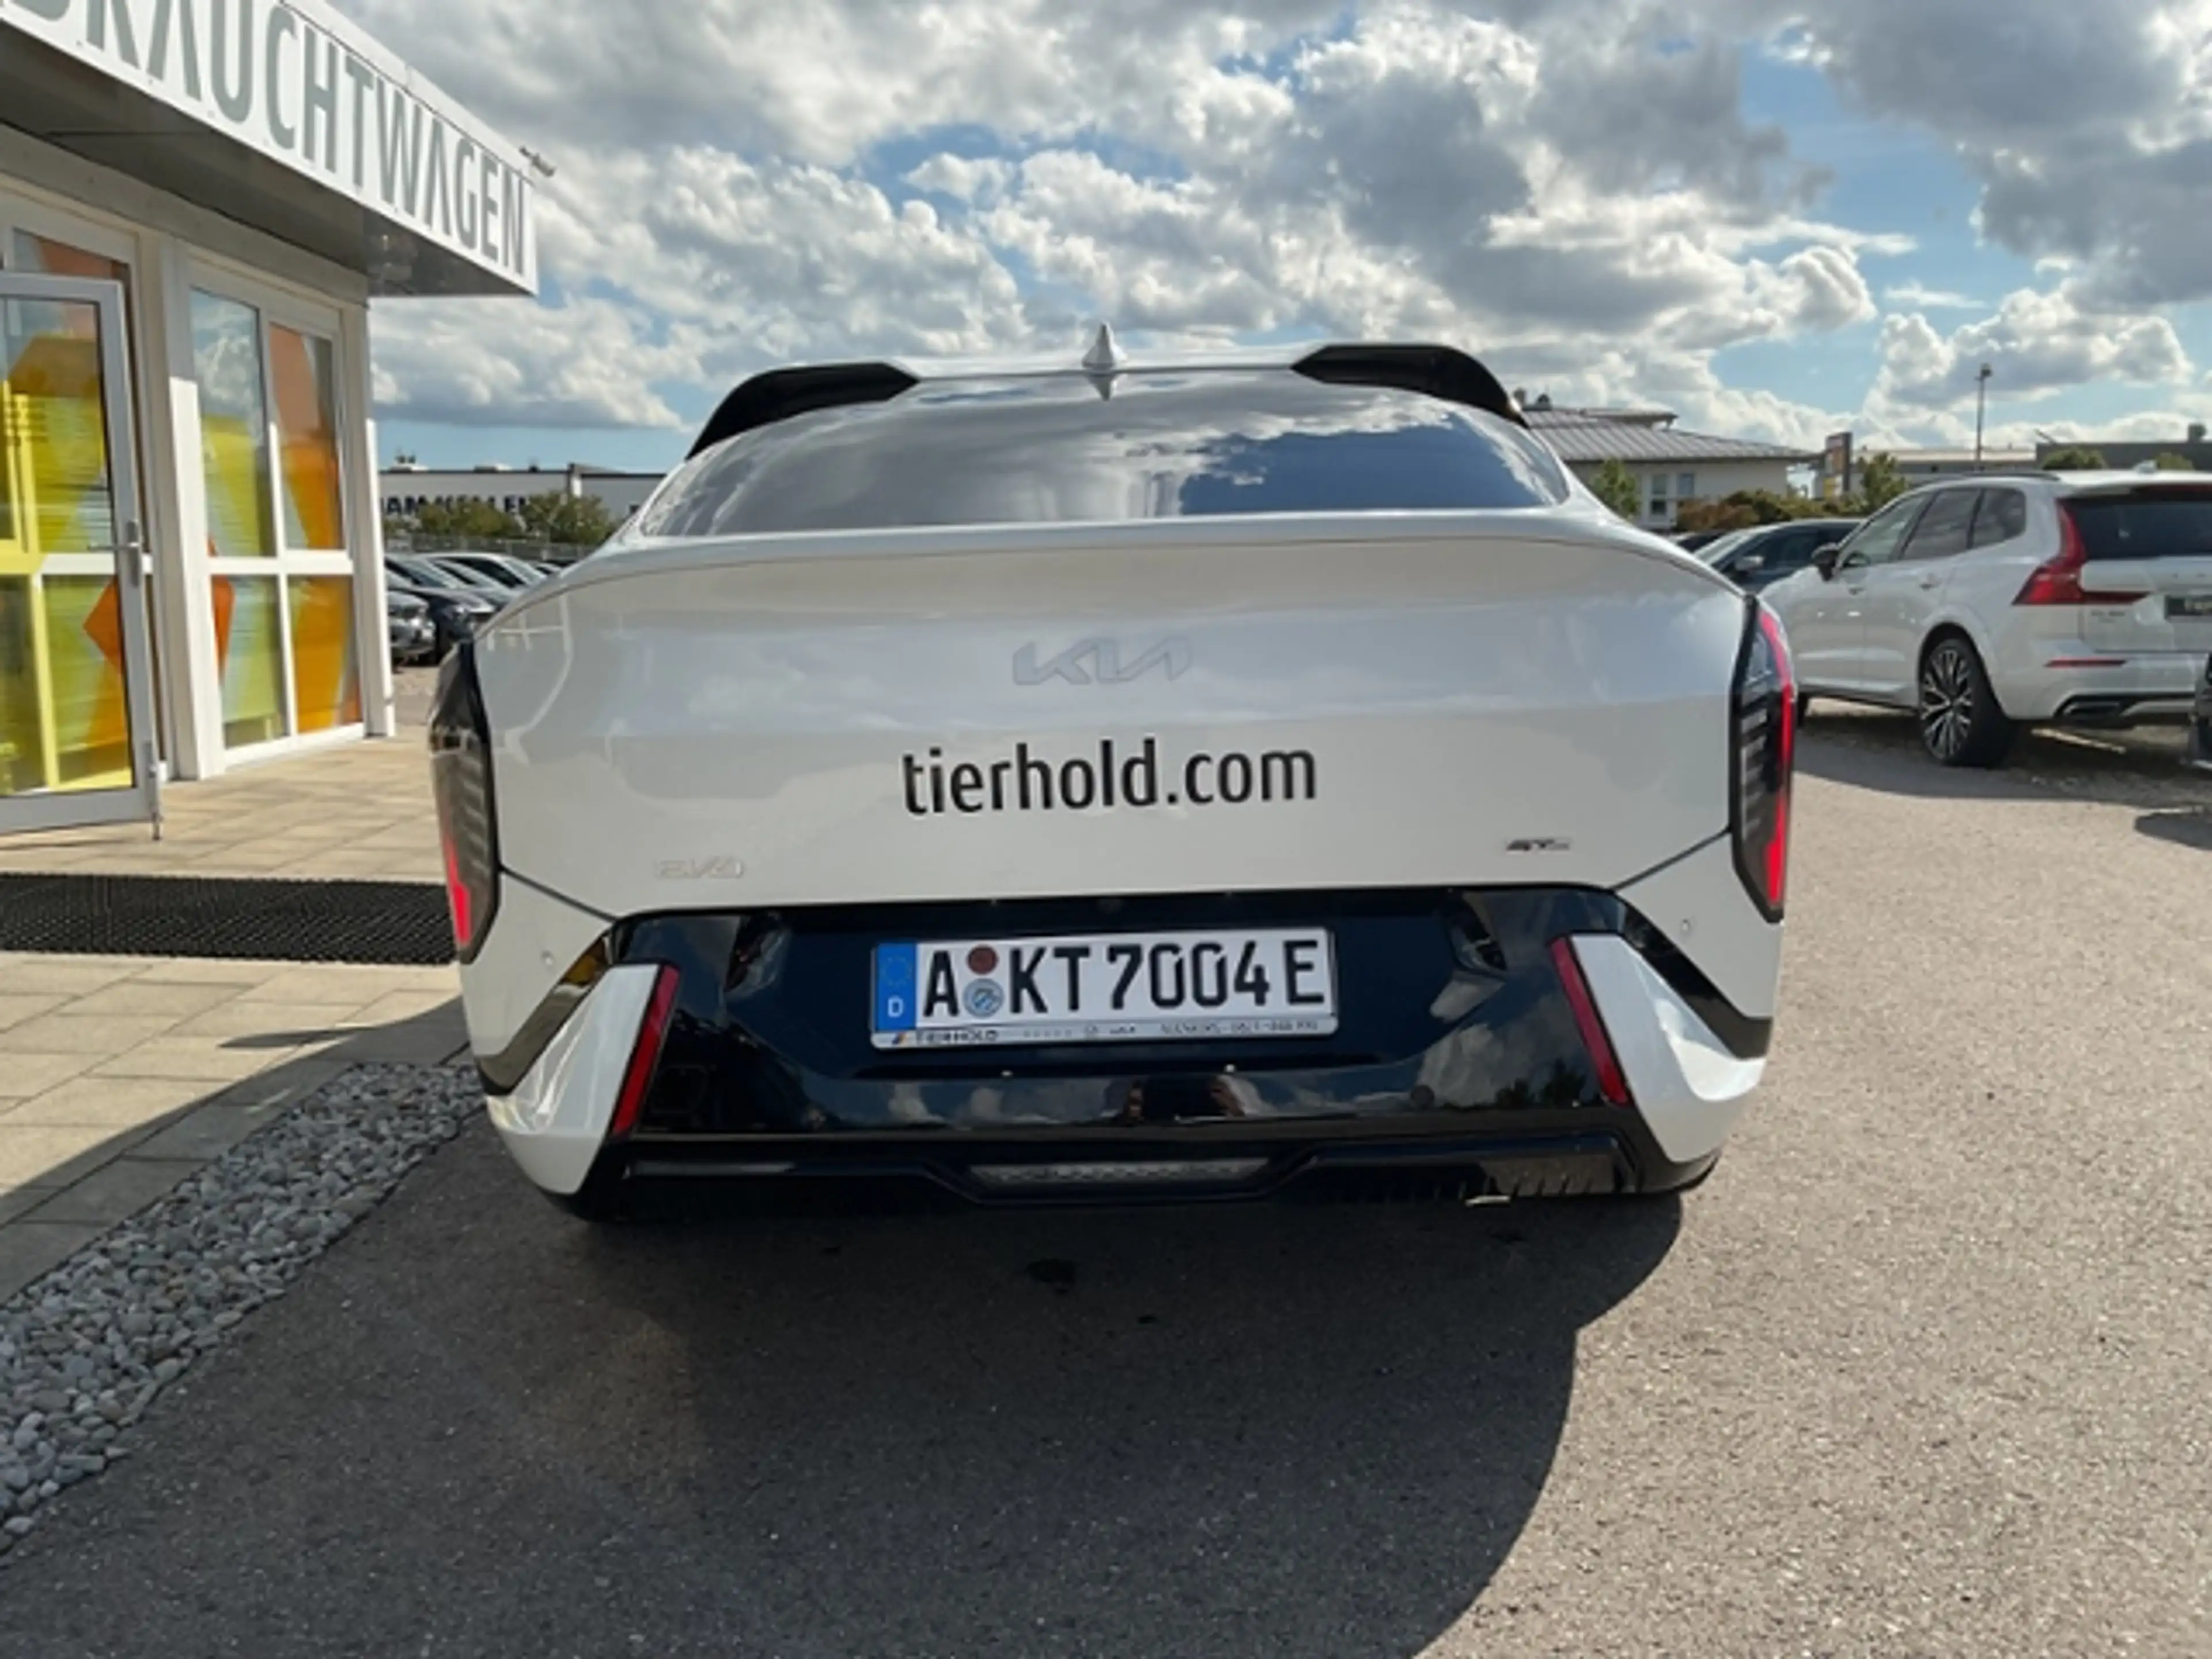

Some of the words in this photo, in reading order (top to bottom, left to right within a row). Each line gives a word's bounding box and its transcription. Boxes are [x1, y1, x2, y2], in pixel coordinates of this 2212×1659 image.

[12, 0, 525, 276] AUCHTWAGEN
[903, 737, 1317, 816] tierhold.com
[888, 997, 904, 1017] D
[923, 950, 959, 1017] A
